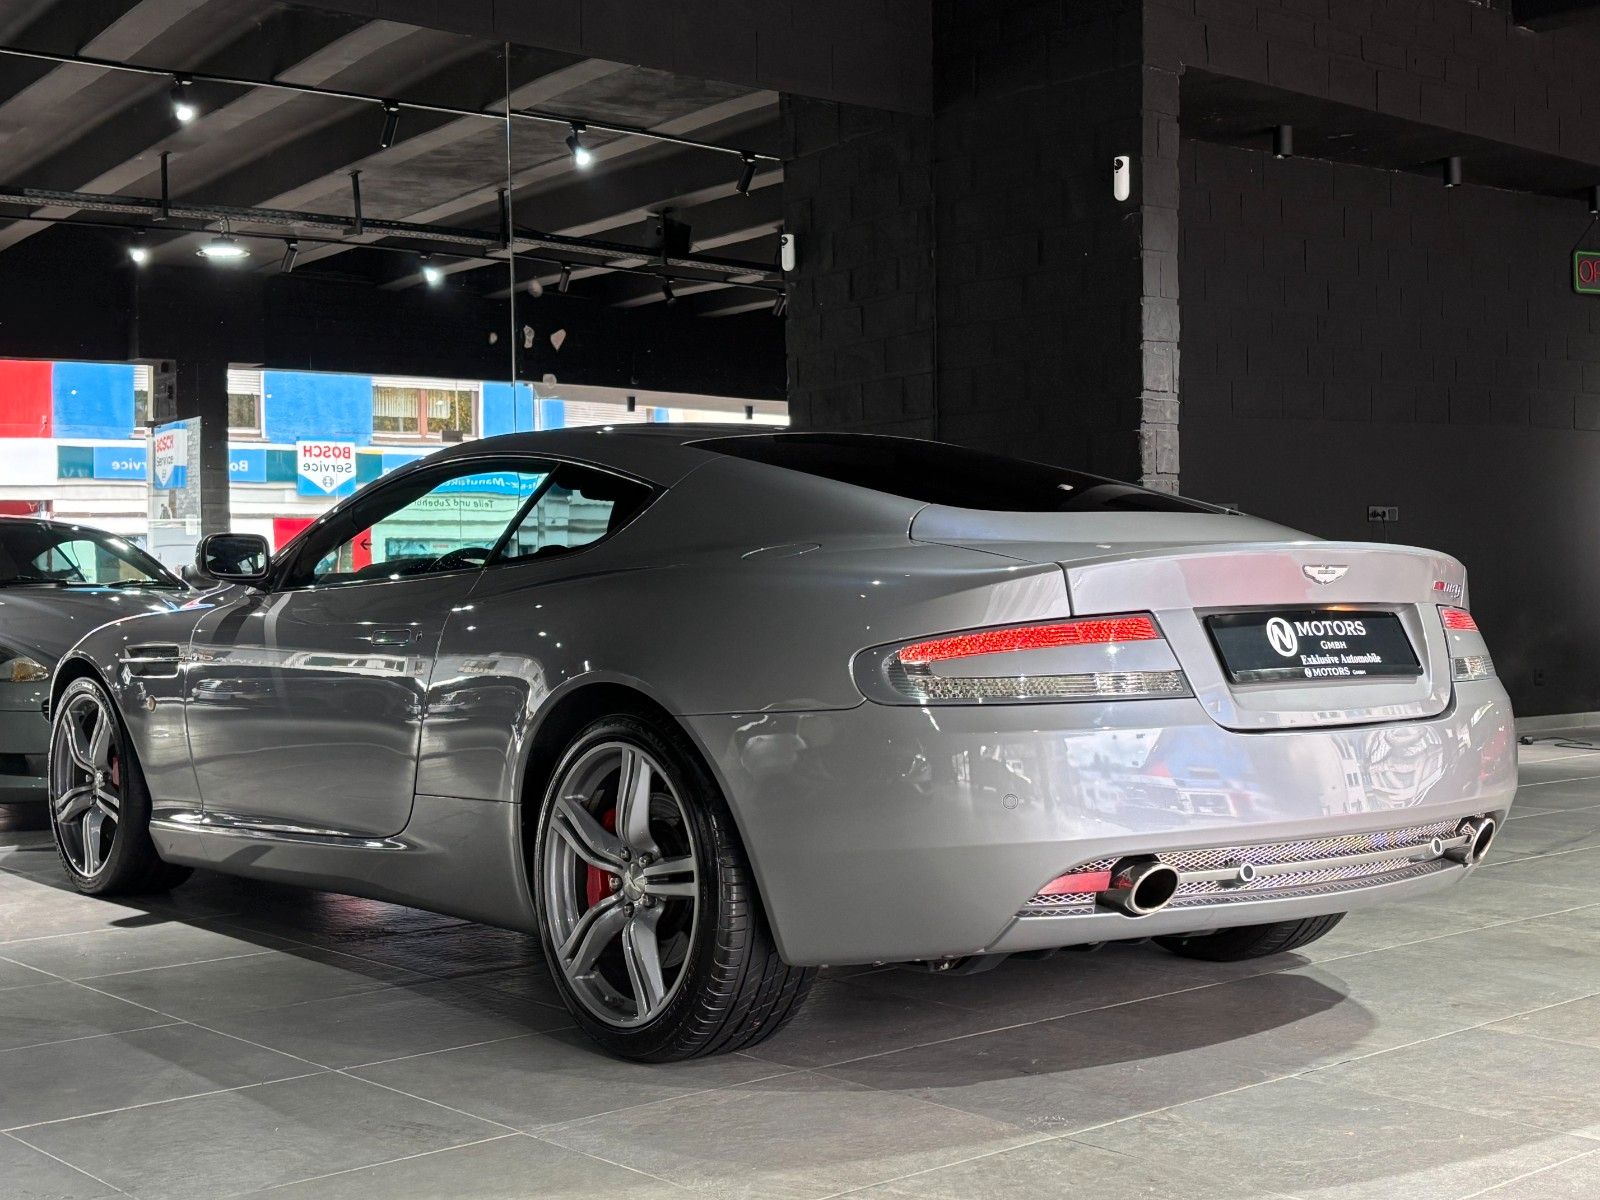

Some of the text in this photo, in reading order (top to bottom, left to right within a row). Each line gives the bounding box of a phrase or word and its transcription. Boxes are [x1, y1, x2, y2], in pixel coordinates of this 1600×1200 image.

[1293, 620, 1367, 637] MOTORS
[1300, 652, 1382, 665] Exklusive Automobile
[1312, 667, 1351, 677] MOTORS
